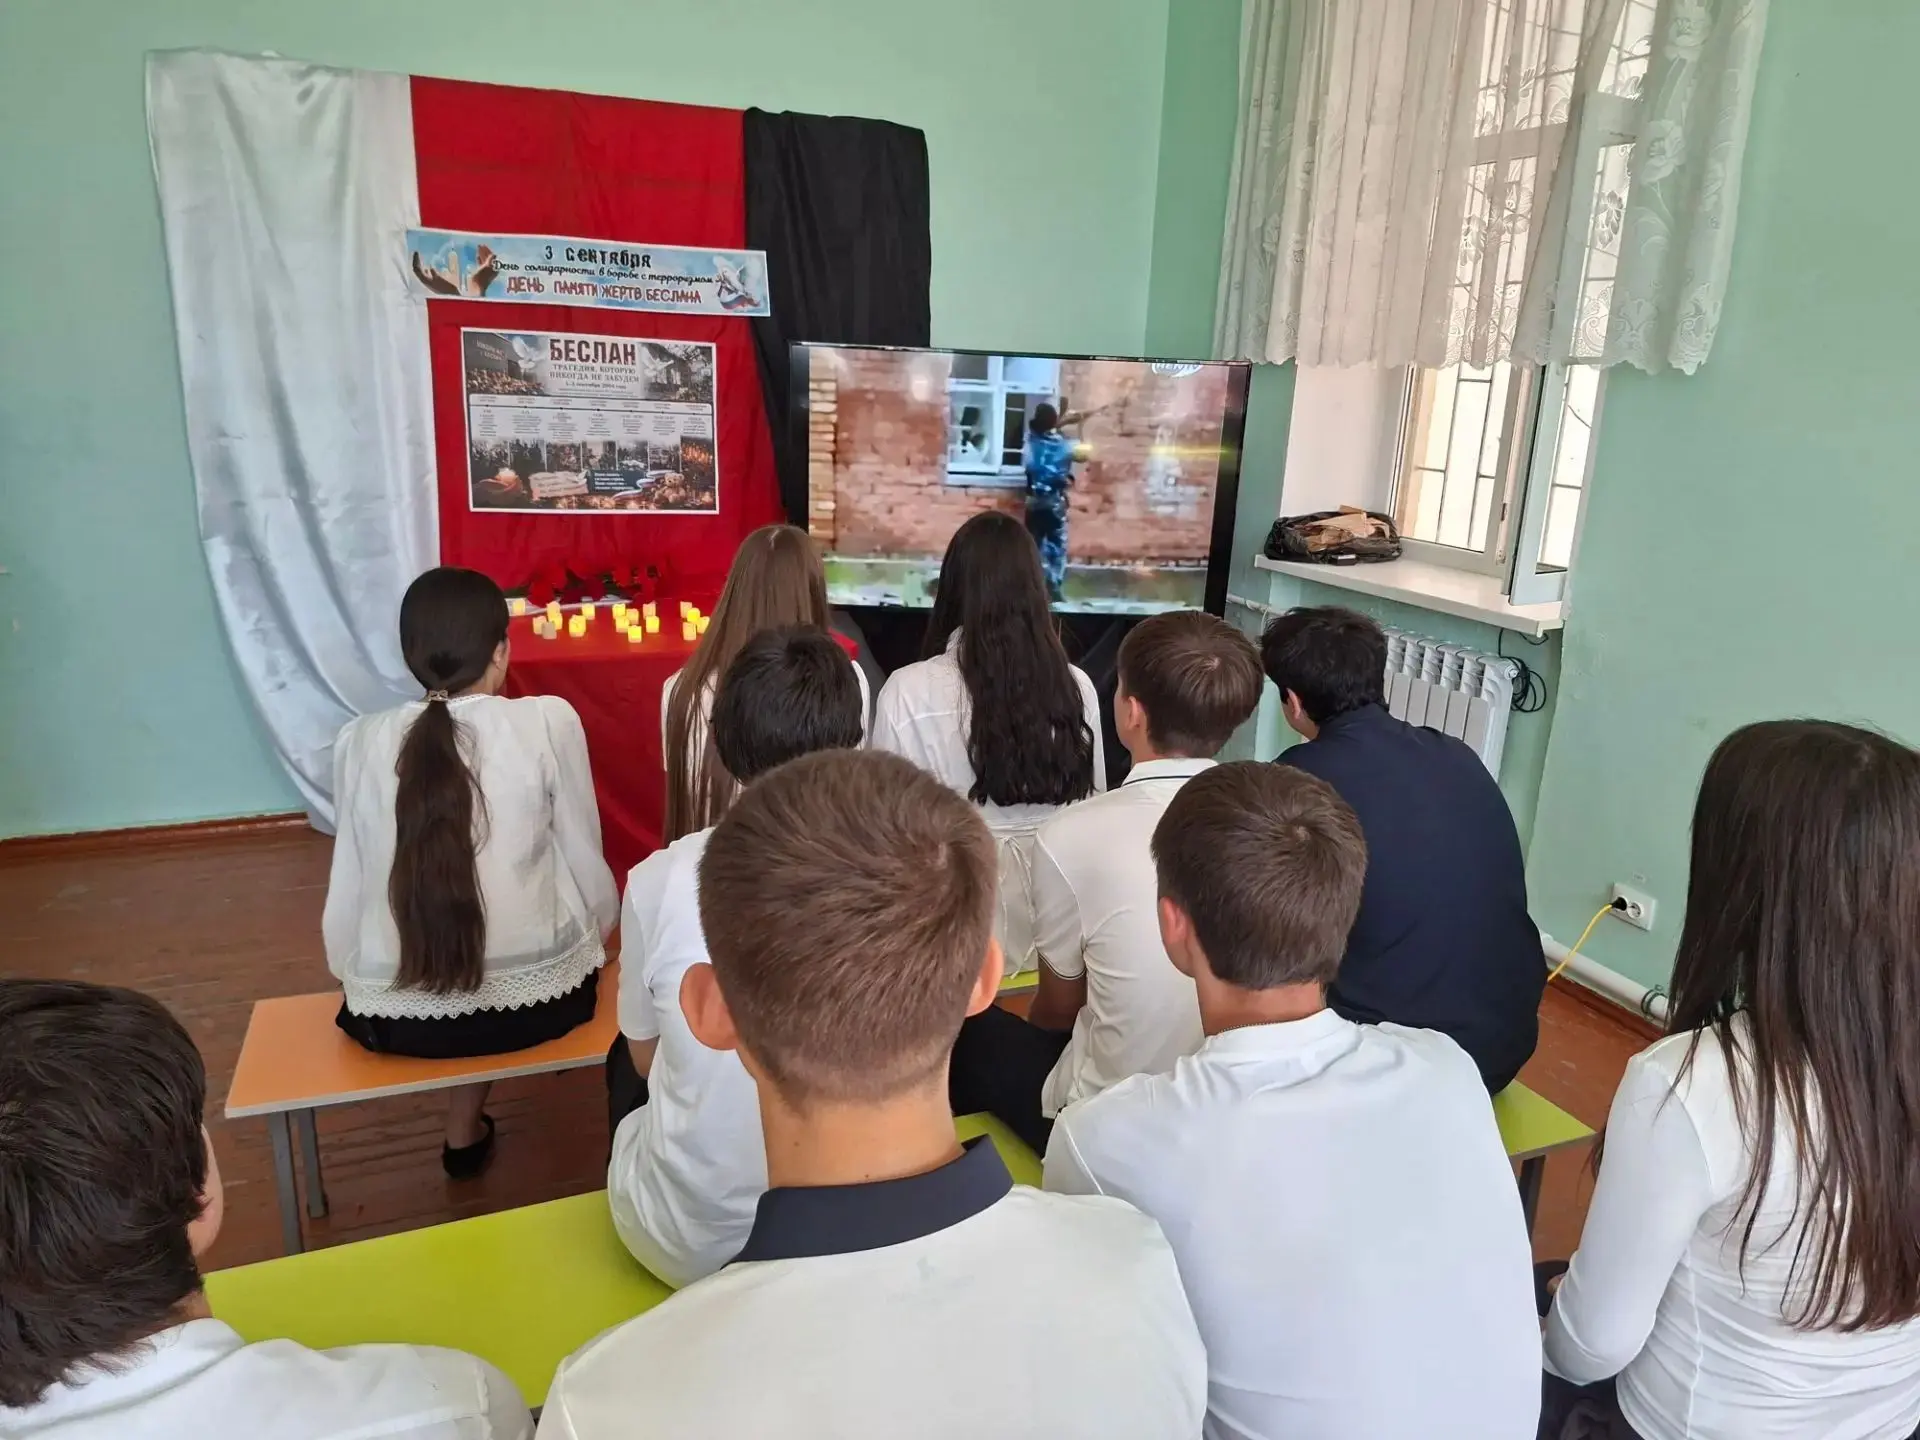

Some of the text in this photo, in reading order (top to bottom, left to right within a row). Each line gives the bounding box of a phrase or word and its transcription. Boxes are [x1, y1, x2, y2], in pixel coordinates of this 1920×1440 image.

[545, 245, 553, 260] 3
[492, 260, 519, 271] День
[525, 264, 595, 276] солидарности
[599, 268, 605, 276] в
[607, 267, 639, 280] борьбе
[648, 274, 713, 286] терроризмом
[507, 275, 702, 304] ДЕНЬ ПАМЯТИ ЖЕРТВ БЕСЛАНА
[550, 339, 636, 366] БЕСЛАН
